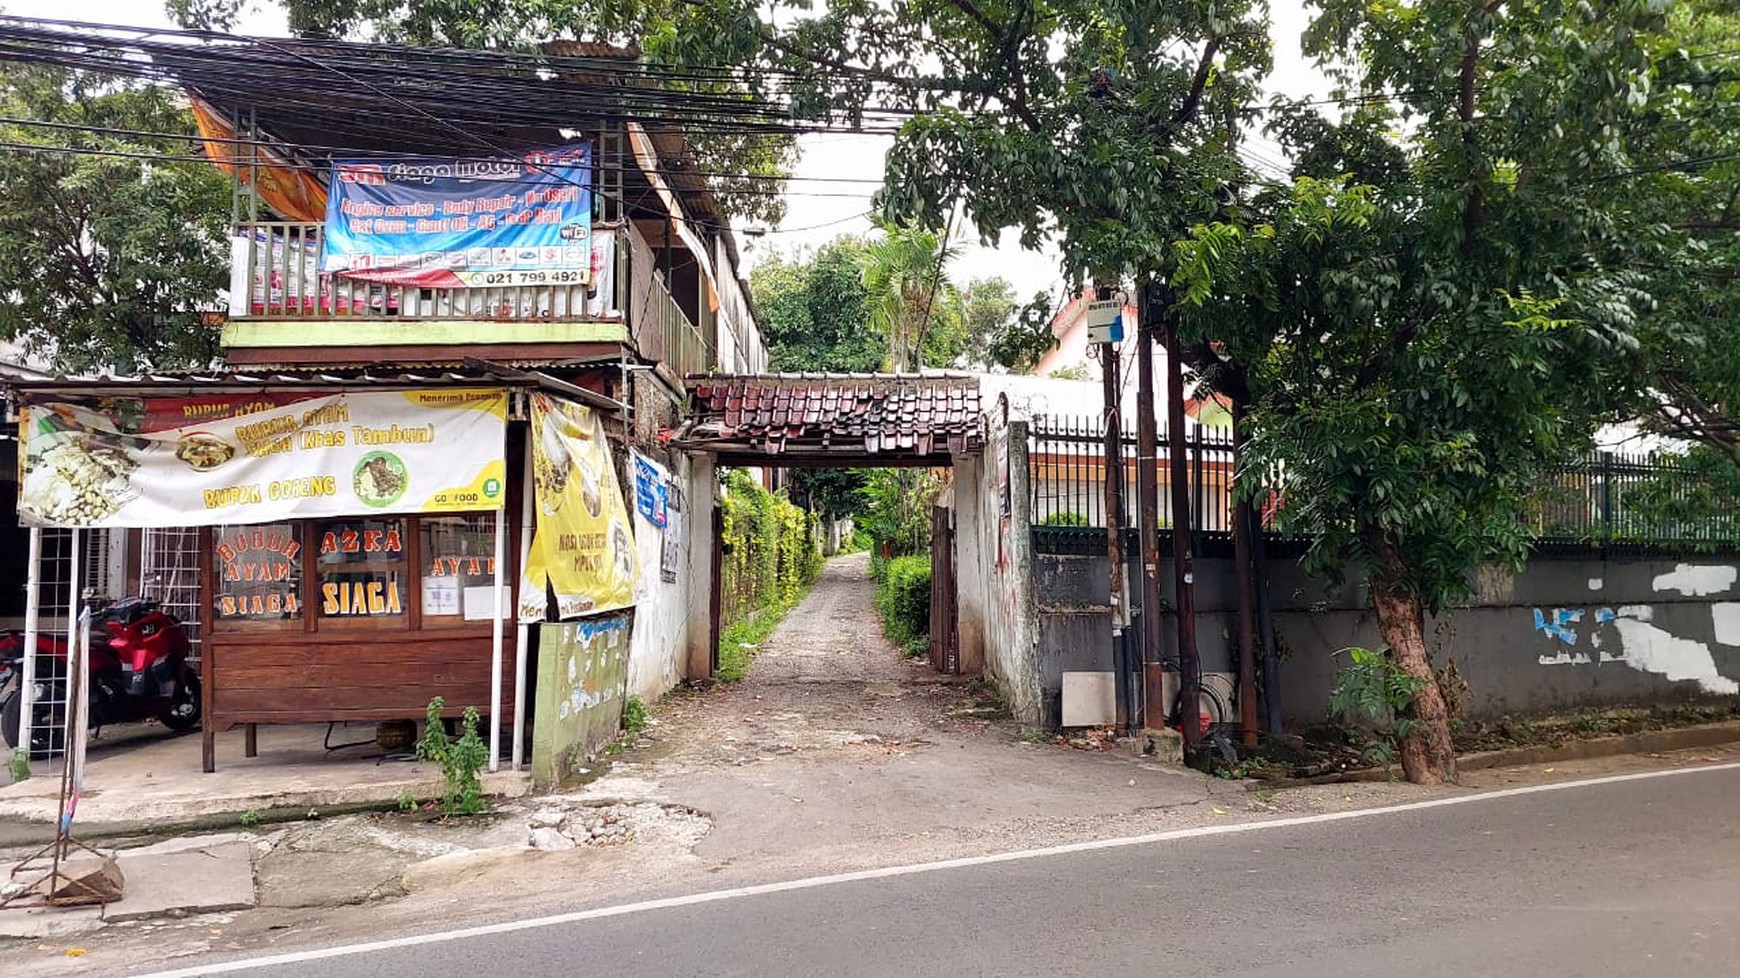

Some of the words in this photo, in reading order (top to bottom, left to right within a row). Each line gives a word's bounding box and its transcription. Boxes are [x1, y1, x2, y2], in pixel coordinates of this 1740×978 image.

[341, 198, 384, 217] Engine
[385, 203, 434, 217] service
[476, 194, 516, 212] Repair
[486, 273, 512, 284] 021
[520, 272, 546, 282] 799
[551, 271, 584, 282] 4921
[351, 422, 435, 446] Tambun)
[268, 476, 336, 501] GORENG
[216, 530, 300, 563] BUBUR
[320, 529, 402, 554] AZKA
[224, 562, 290, 581] AYAM
[221, 593, 298, 615] SIAGA
[322, 581, 401, 614] SIAGA
